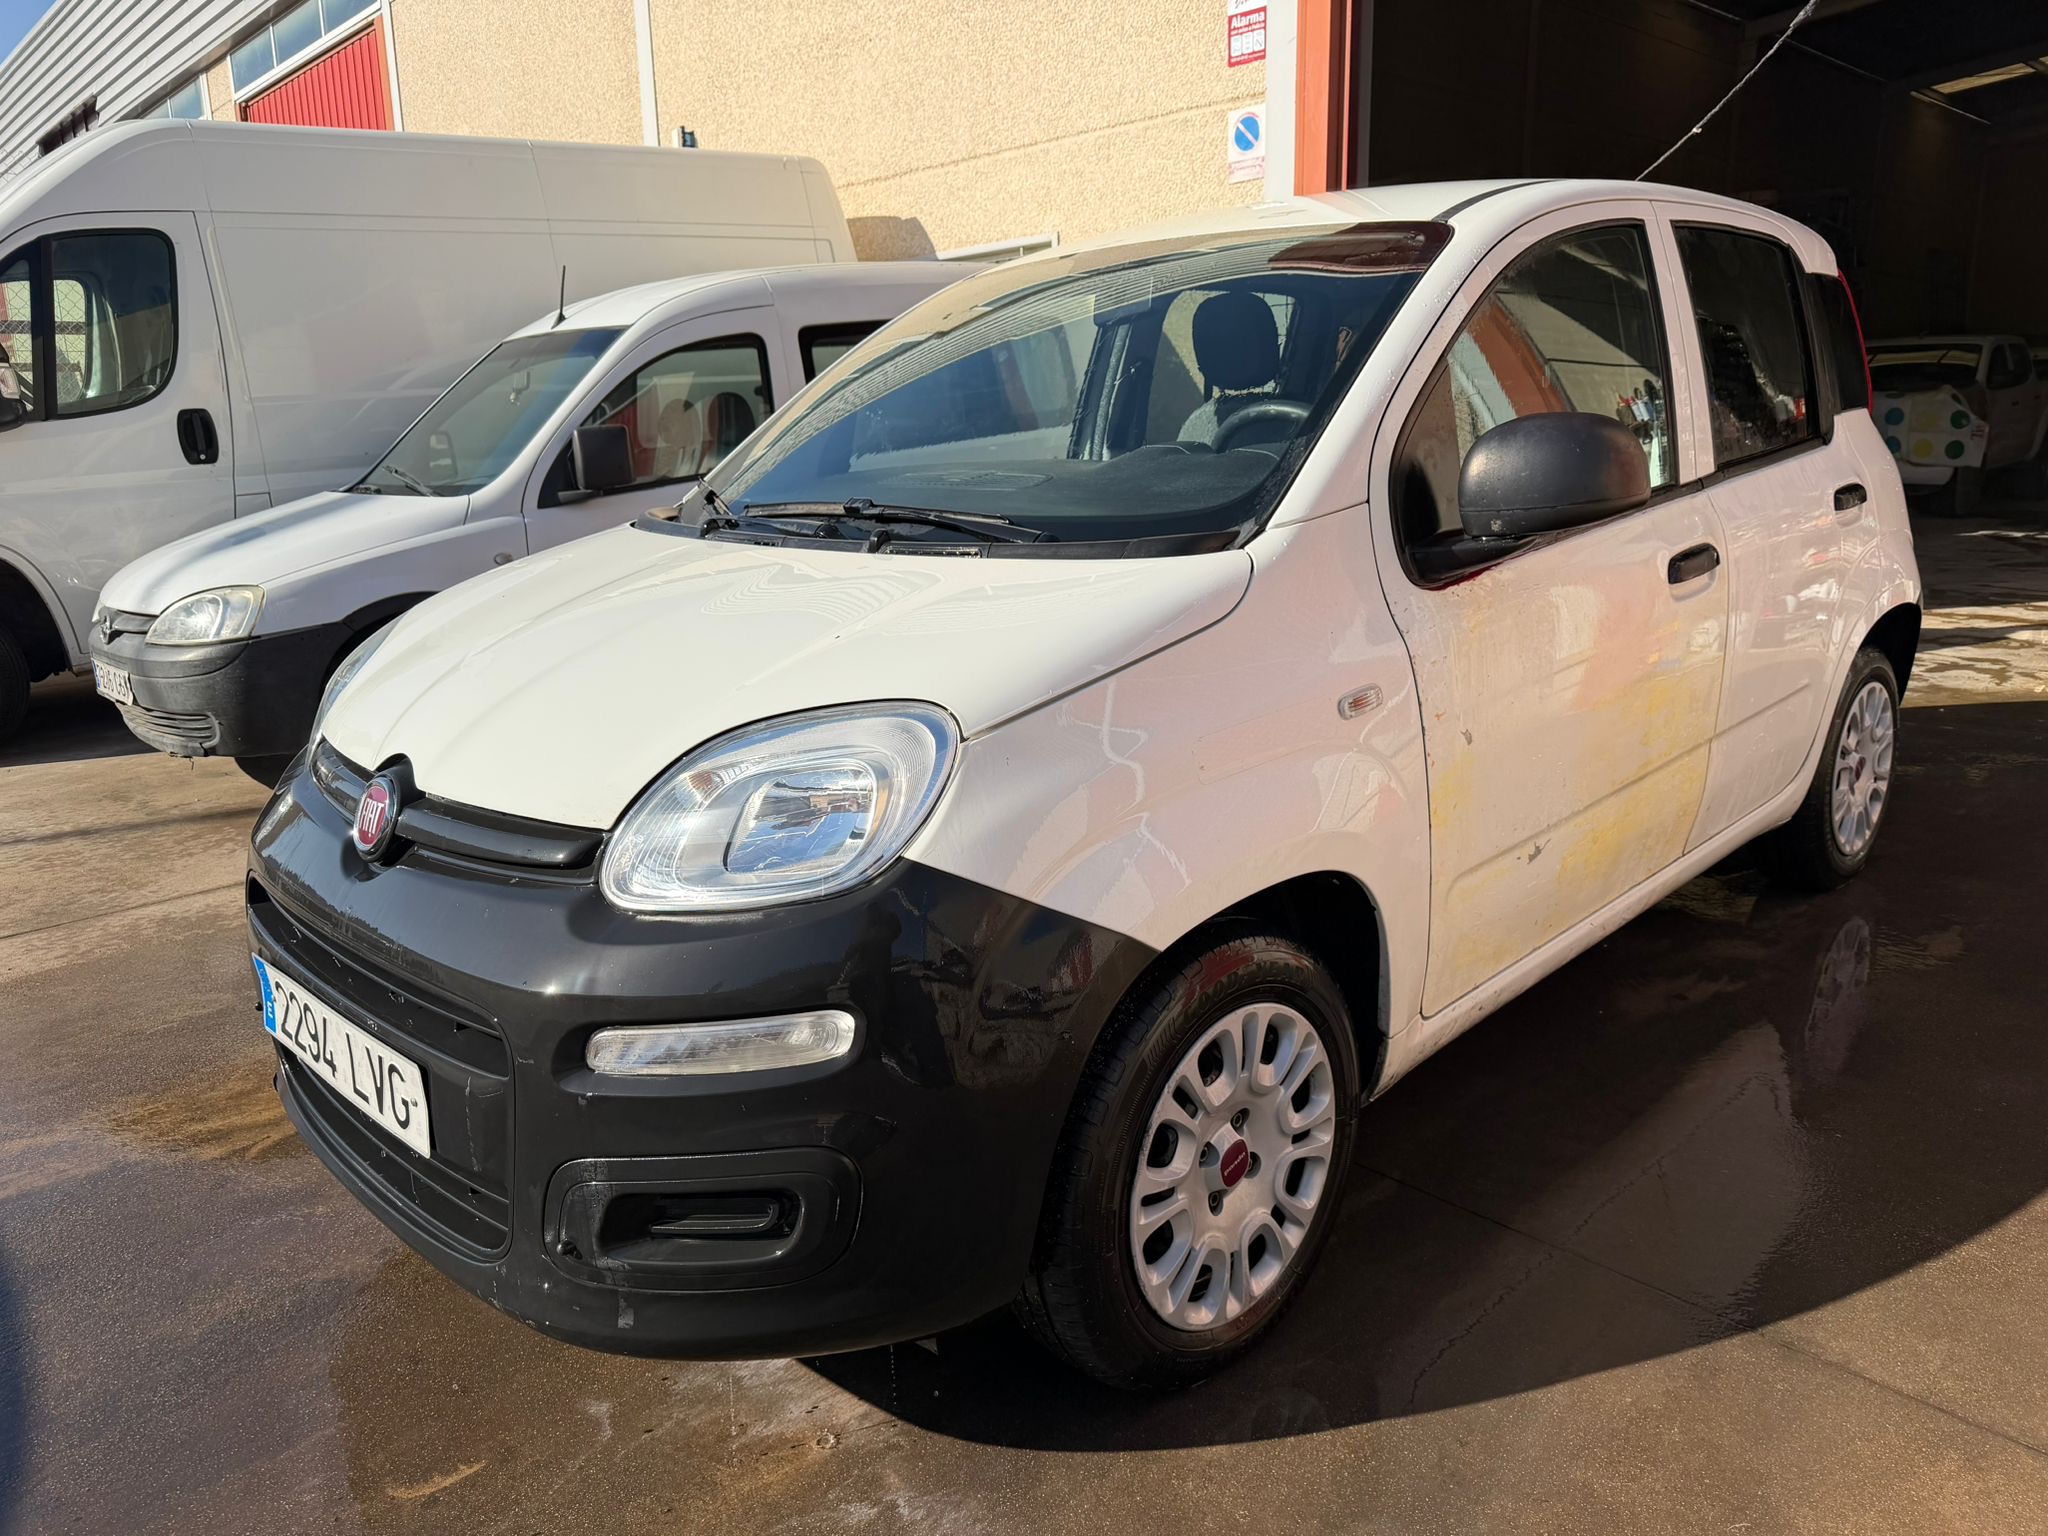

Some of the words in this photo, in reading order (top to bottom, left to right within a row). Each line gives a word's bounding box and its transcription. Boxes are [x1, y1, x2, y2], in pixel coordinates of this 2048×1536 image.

[1230, 11, 1265, 30] Alarma
[360, 797, 385, 836] FIAT
[274, 981, 337, 1079] 2294
[346, 1032, 410, 1130] LVG
